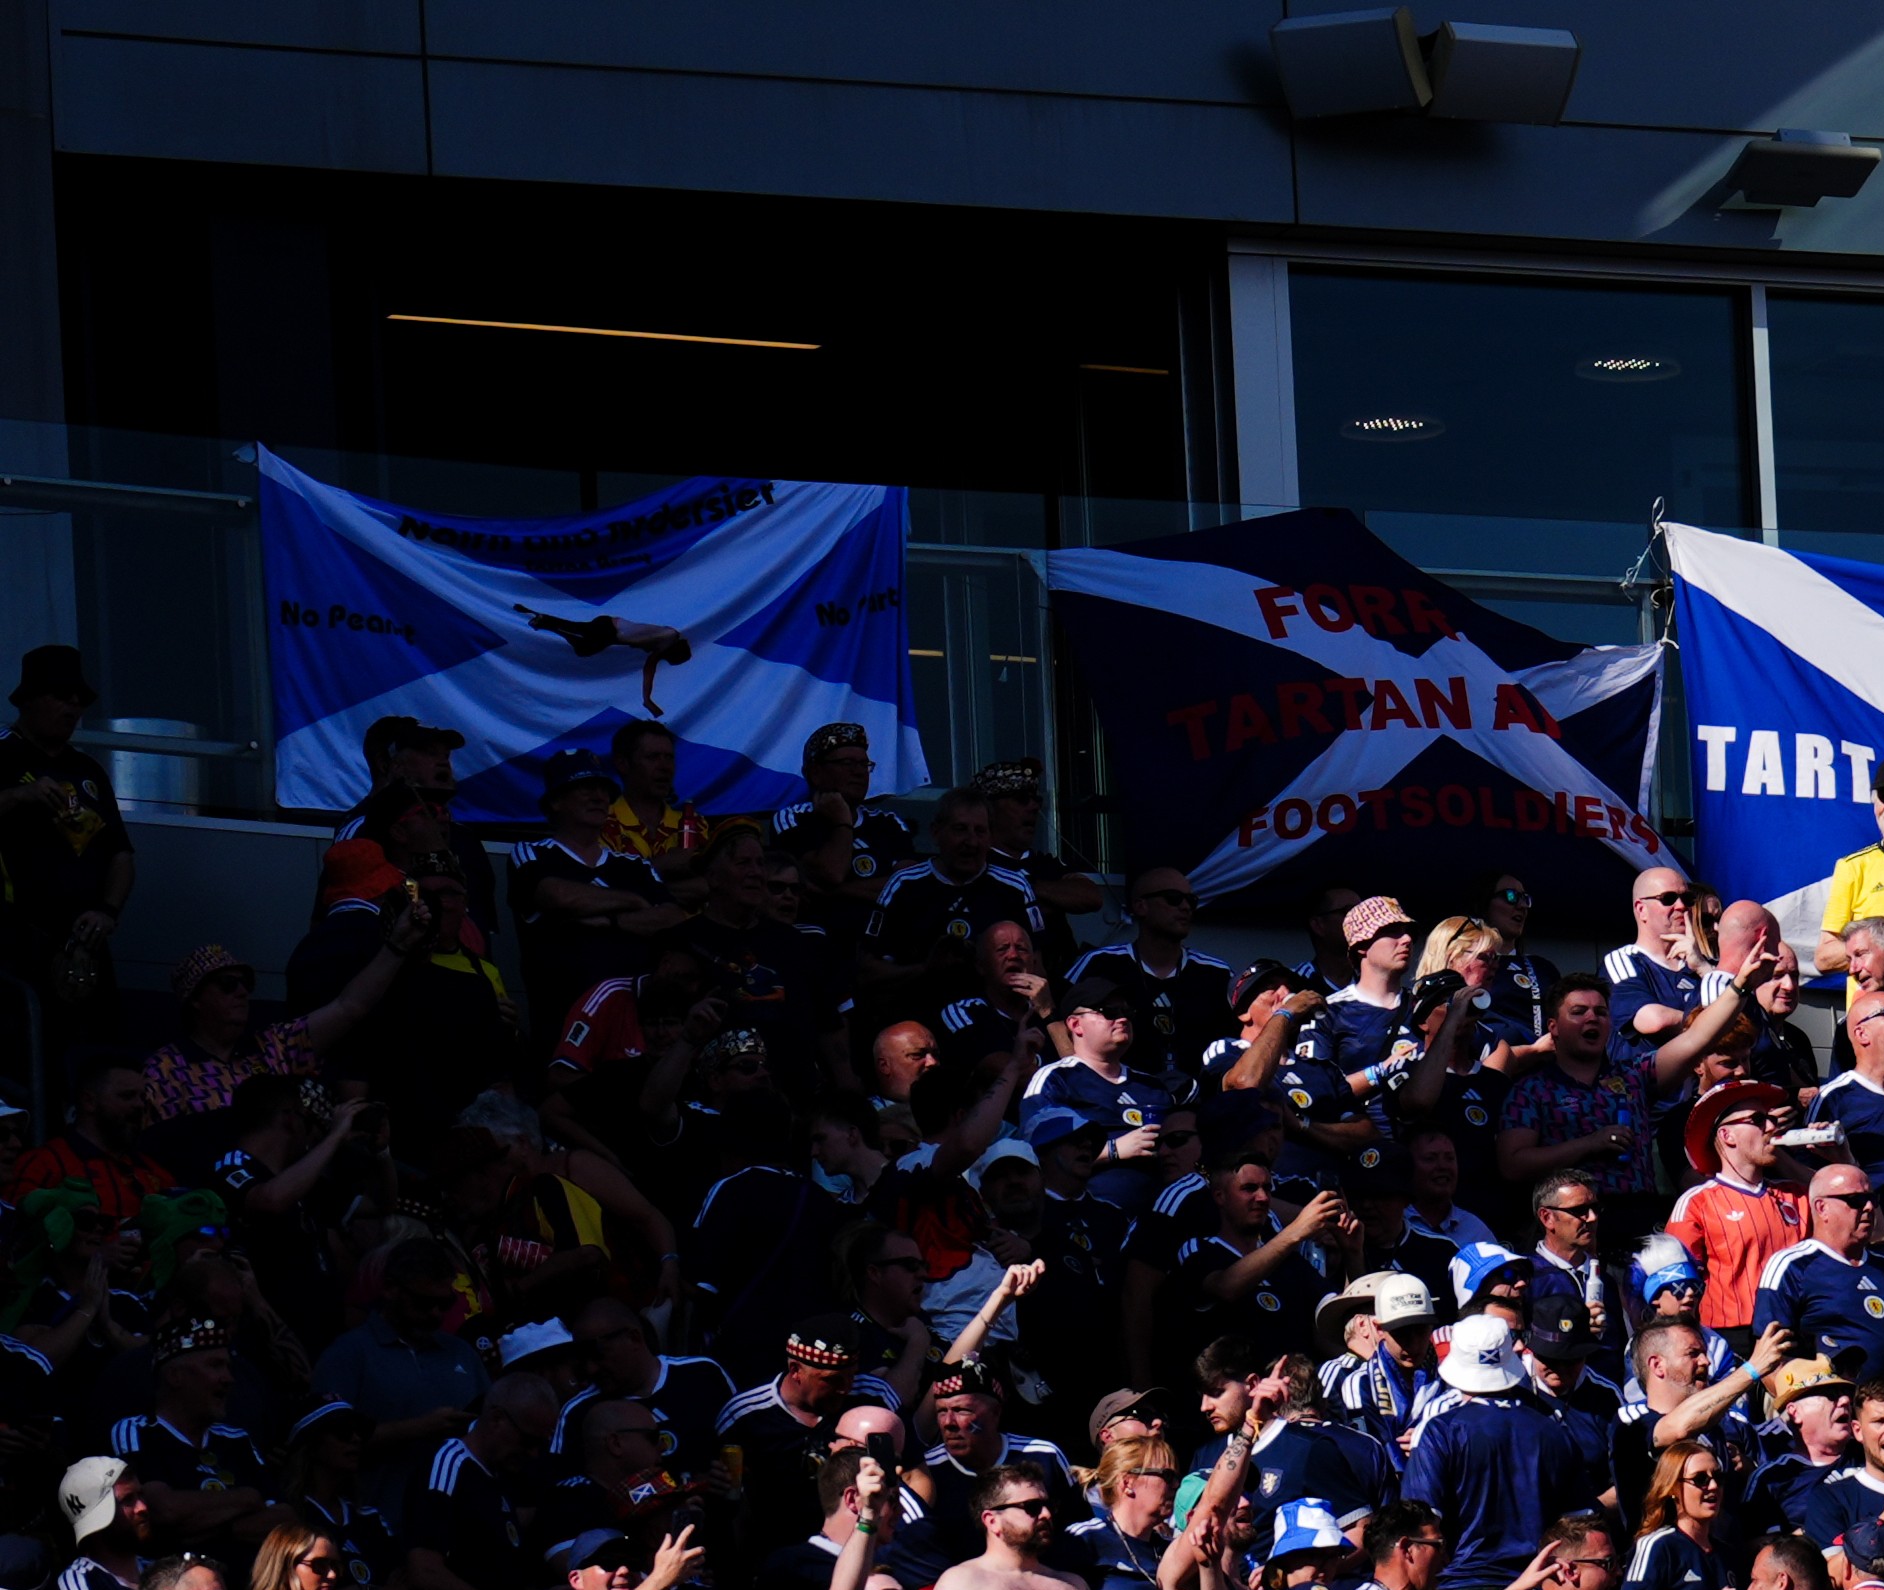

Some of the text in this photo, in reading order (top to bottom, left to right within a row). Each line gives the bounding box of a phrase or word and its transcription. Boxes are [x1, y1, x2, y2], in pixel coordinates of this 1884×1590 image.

[281, 600, 320, 628] No
[815, 600, 852, 627] No
[1166, 677, 1471, 762] TARTAN
[1238, 783, 1658, 855] FOOTSOLDIERS
